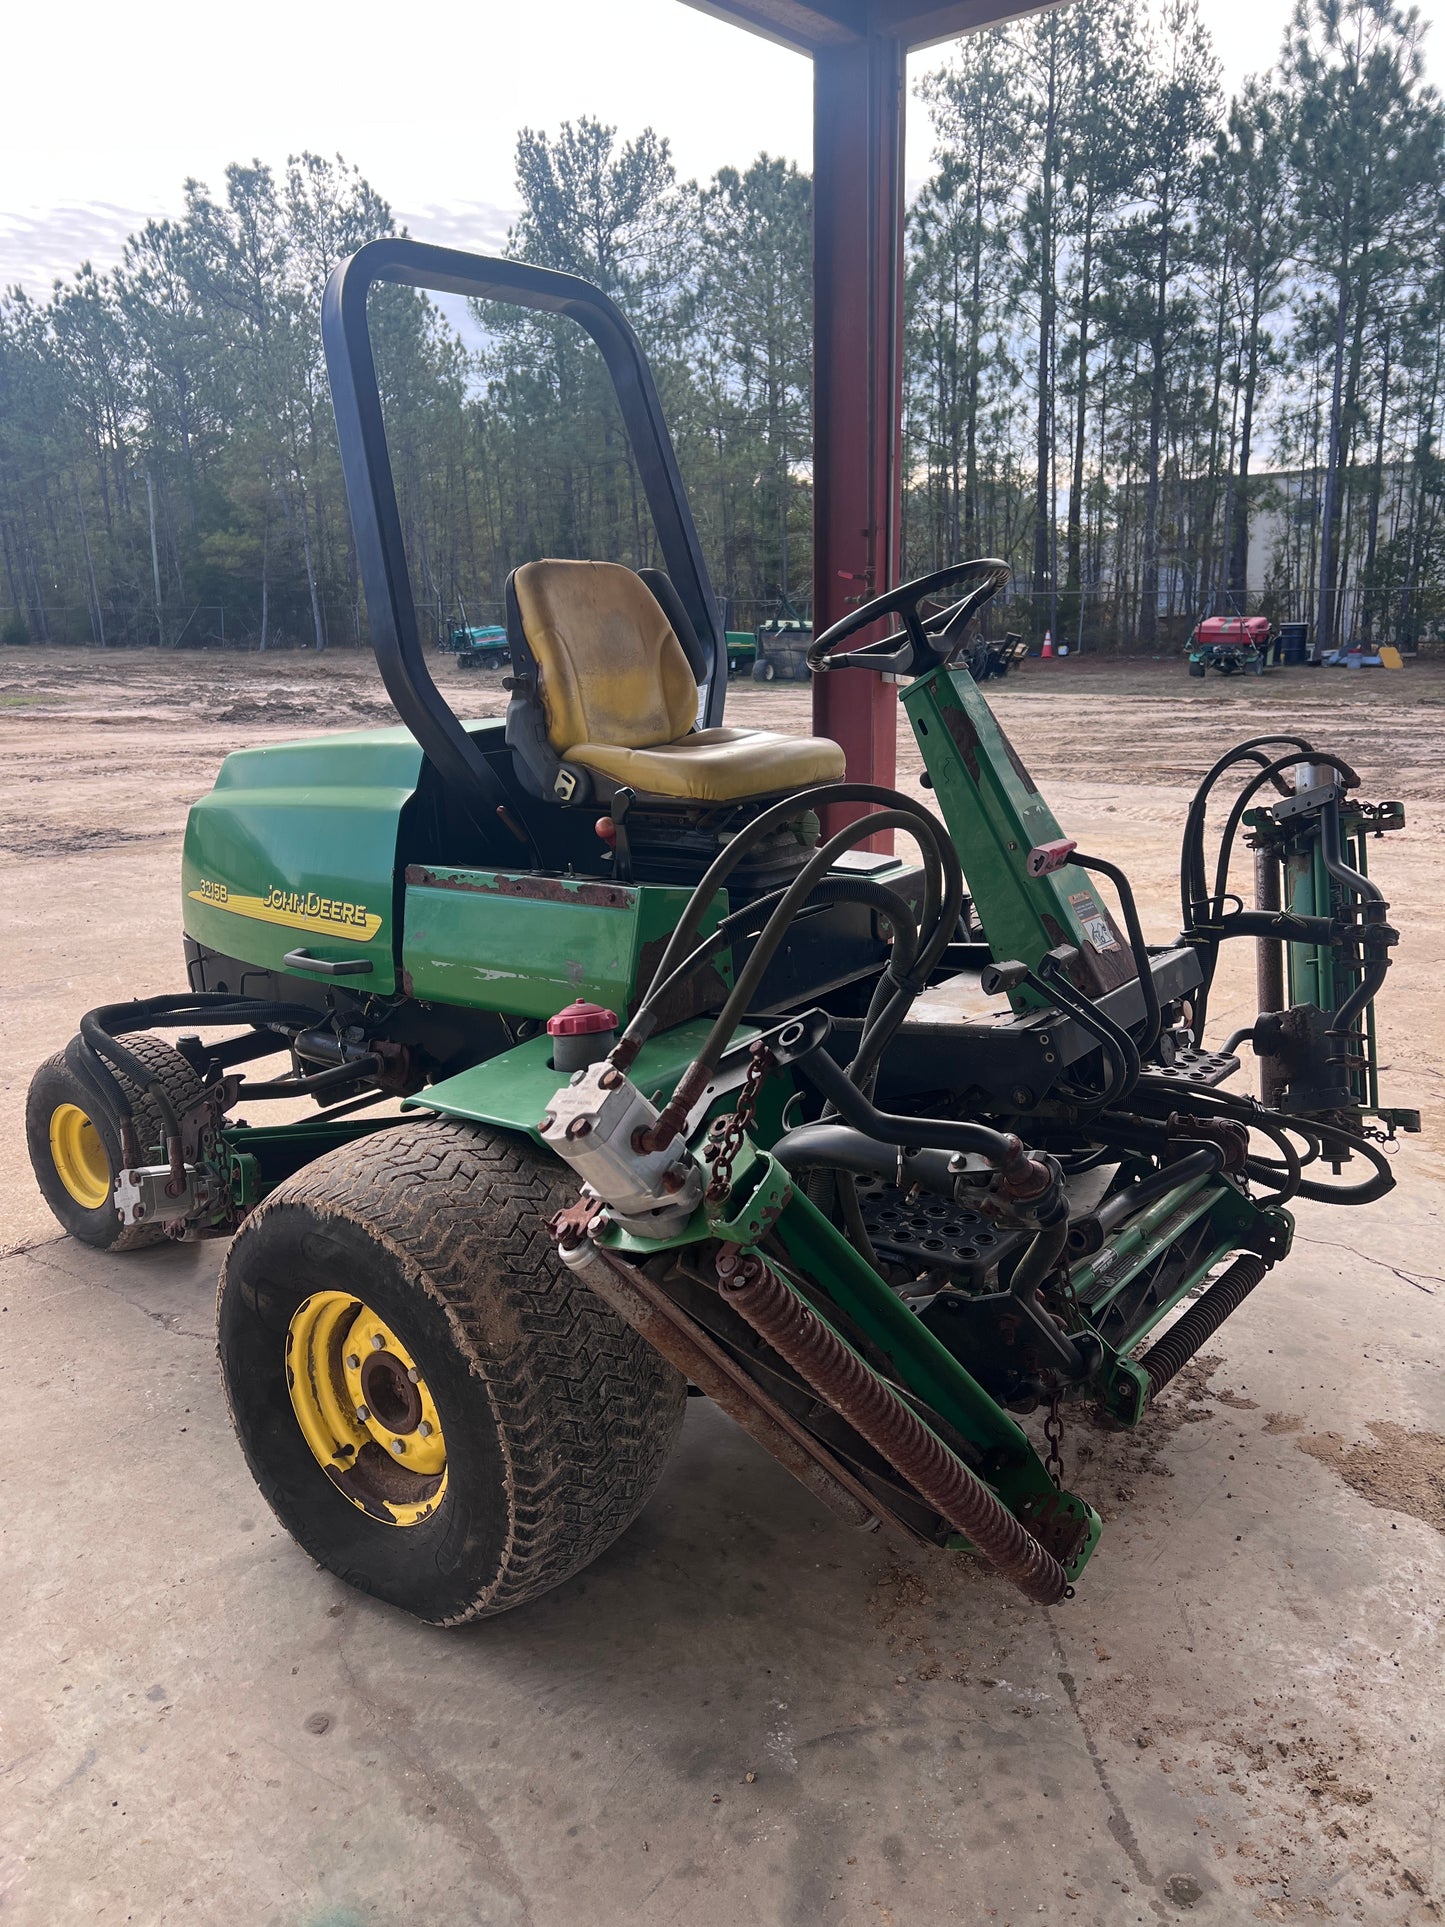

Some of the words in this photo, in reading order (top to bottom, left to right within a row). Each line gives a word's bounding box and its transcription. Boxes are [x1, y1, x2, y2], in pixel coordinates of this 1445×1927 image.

[200, 879, 228, 903] 3215B
[263, 885, 306, 914] JOHN
[306, 892, 367, 927] DEERE
